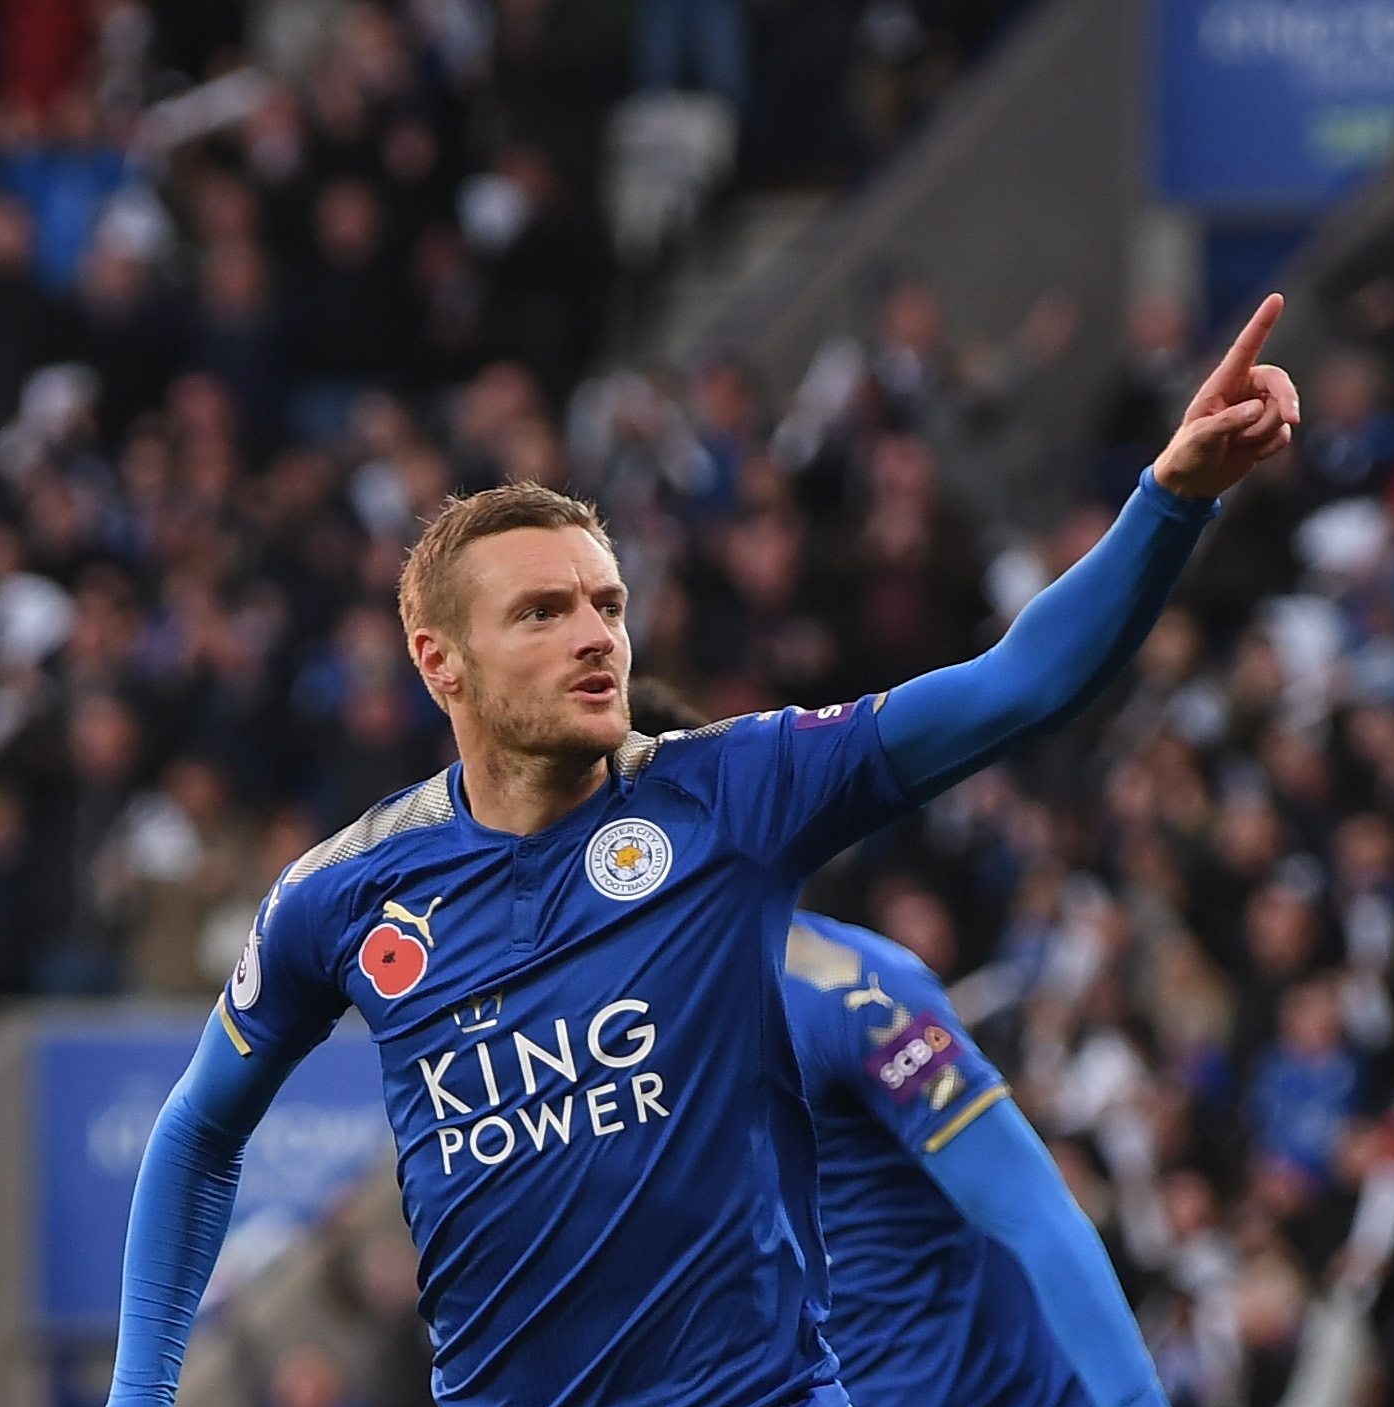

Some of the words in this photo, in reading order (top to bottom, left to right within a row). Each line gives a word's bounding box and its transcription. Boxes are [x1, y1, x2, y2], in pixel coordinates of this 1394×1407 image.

[595, 826, 634, 870] LEICESTER
[636, 827, 659, 843] CITY
[600, 873, 653, 891] FOOTBALL
[651, 847, 663, 875] CLUB
[417, 999, 655, 1120] KING
[437, 1072, 670, 1175] POWER
